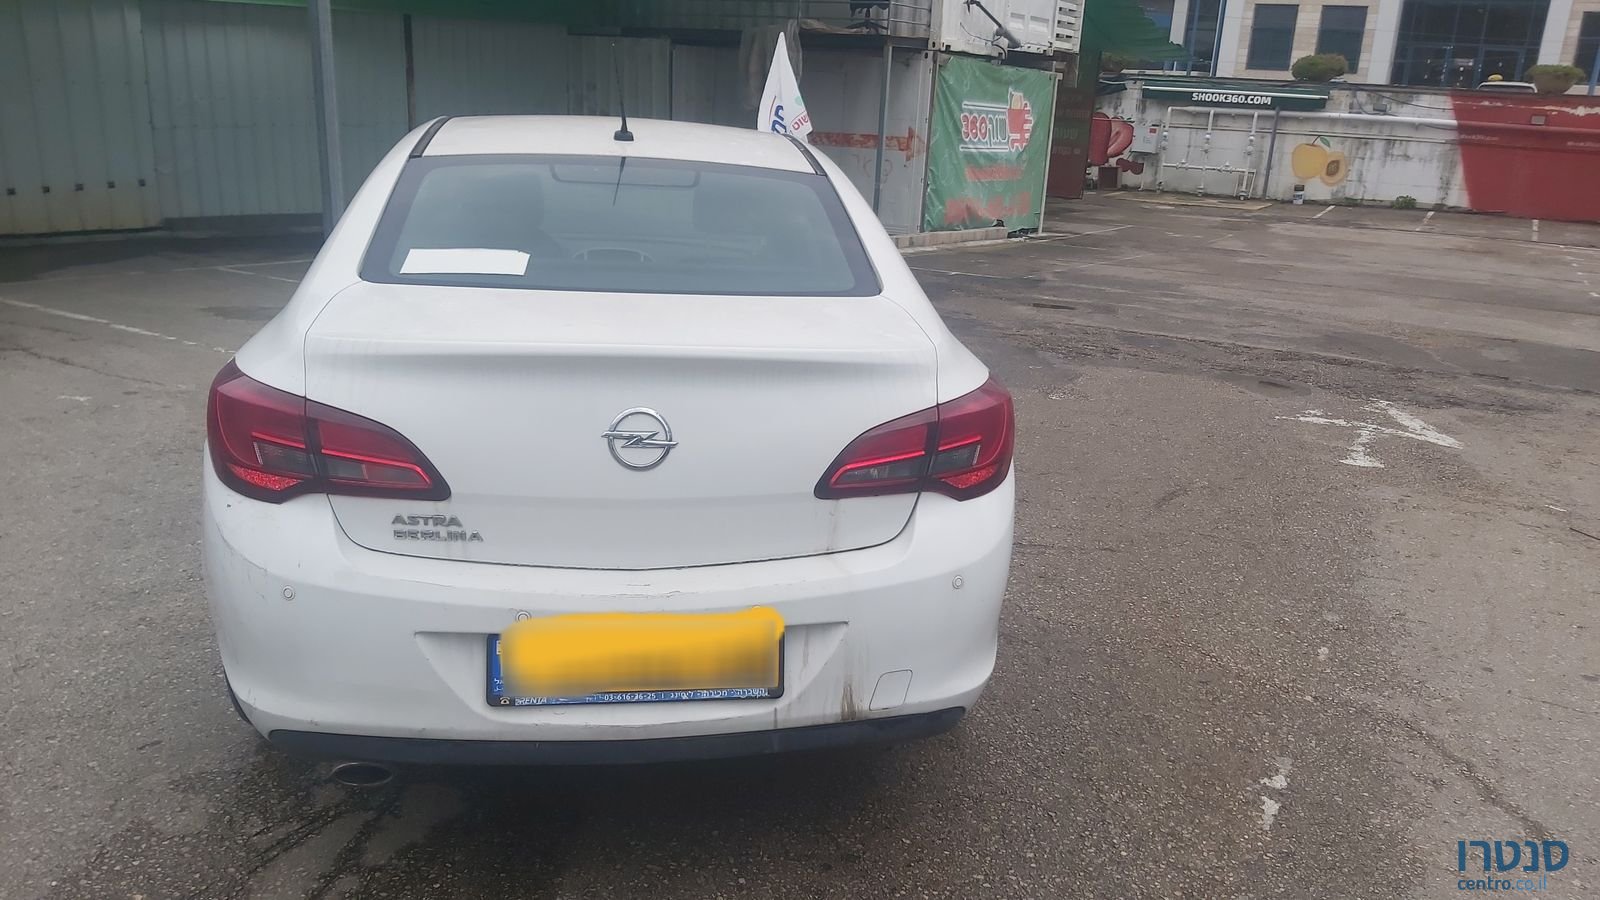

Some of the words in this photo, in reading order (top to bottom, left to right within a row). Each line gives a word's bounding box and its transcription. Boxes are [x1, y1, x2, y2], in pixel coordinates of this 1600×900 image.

[1191, 92, 1272, 105] SHOOK360.COM
[391, 514, 463, 527] ASTRA
[393, 529, 484, 542] BERLINA
